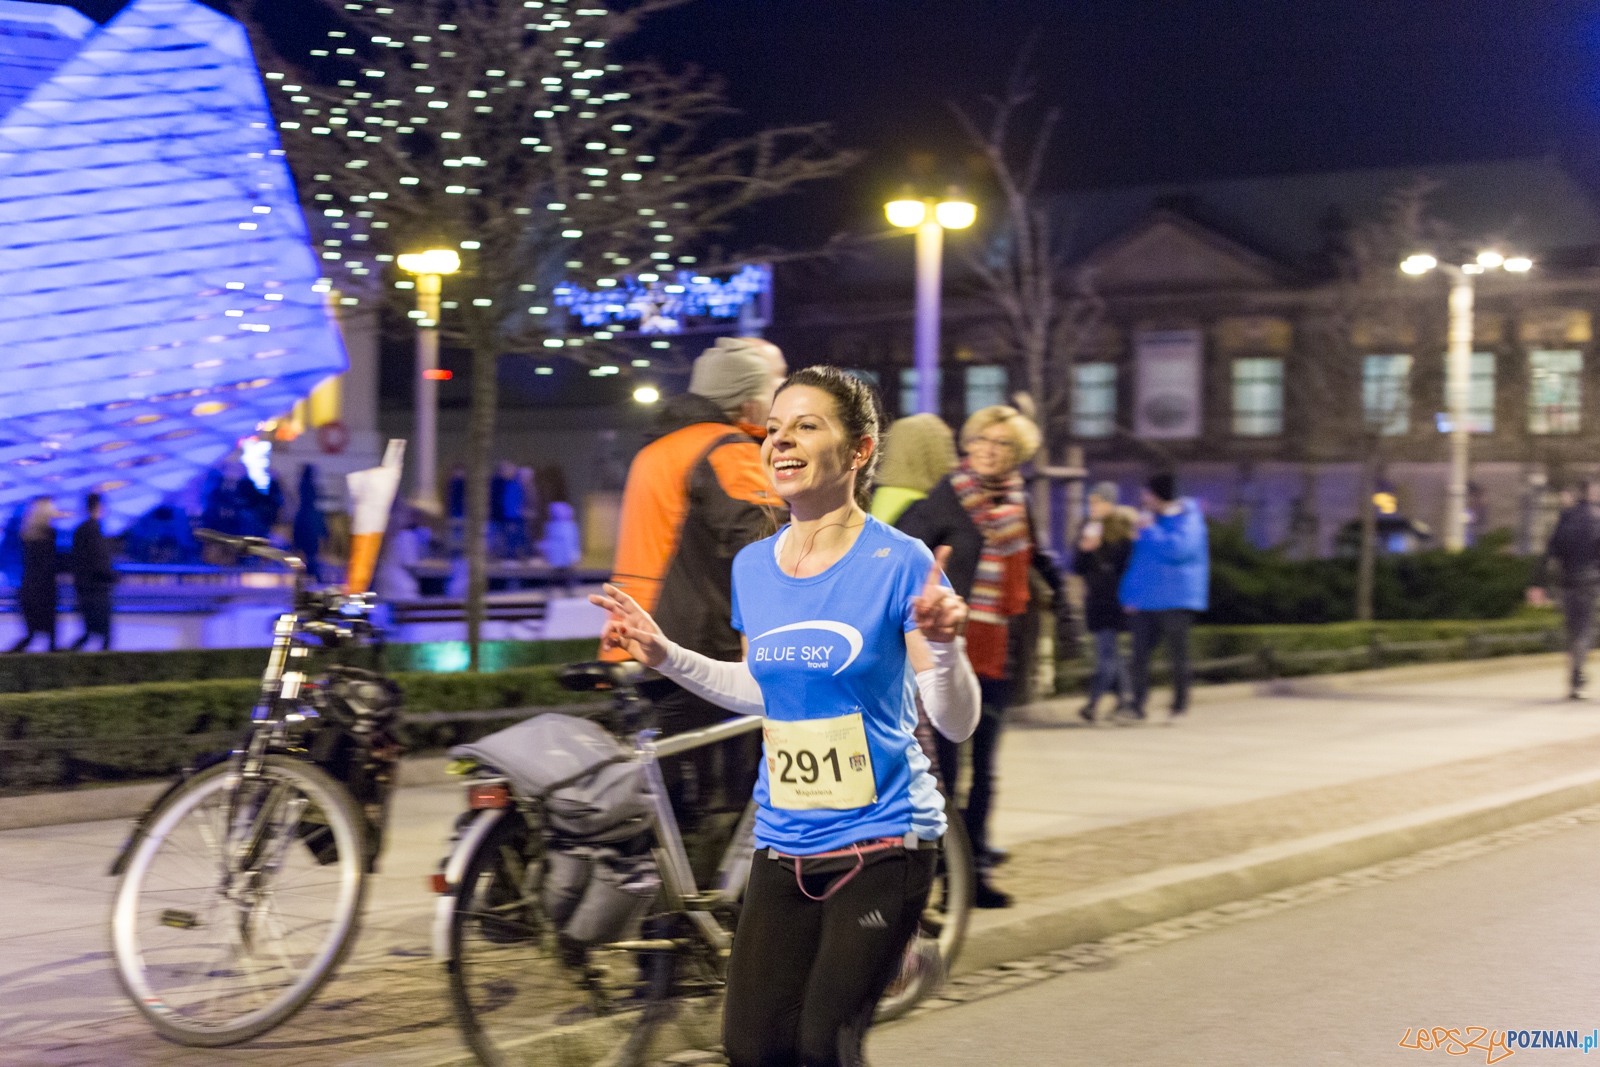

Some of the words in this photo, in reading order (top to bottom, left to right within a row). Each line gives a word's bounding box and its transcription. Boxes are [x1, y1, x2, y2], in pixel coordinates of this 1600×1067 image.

[755, 646, 796, 661] BLUE
[800, 645, 834, 660] SKY
[807, 661, 829, 669] travel
[777, 747, 842, 784] 291
